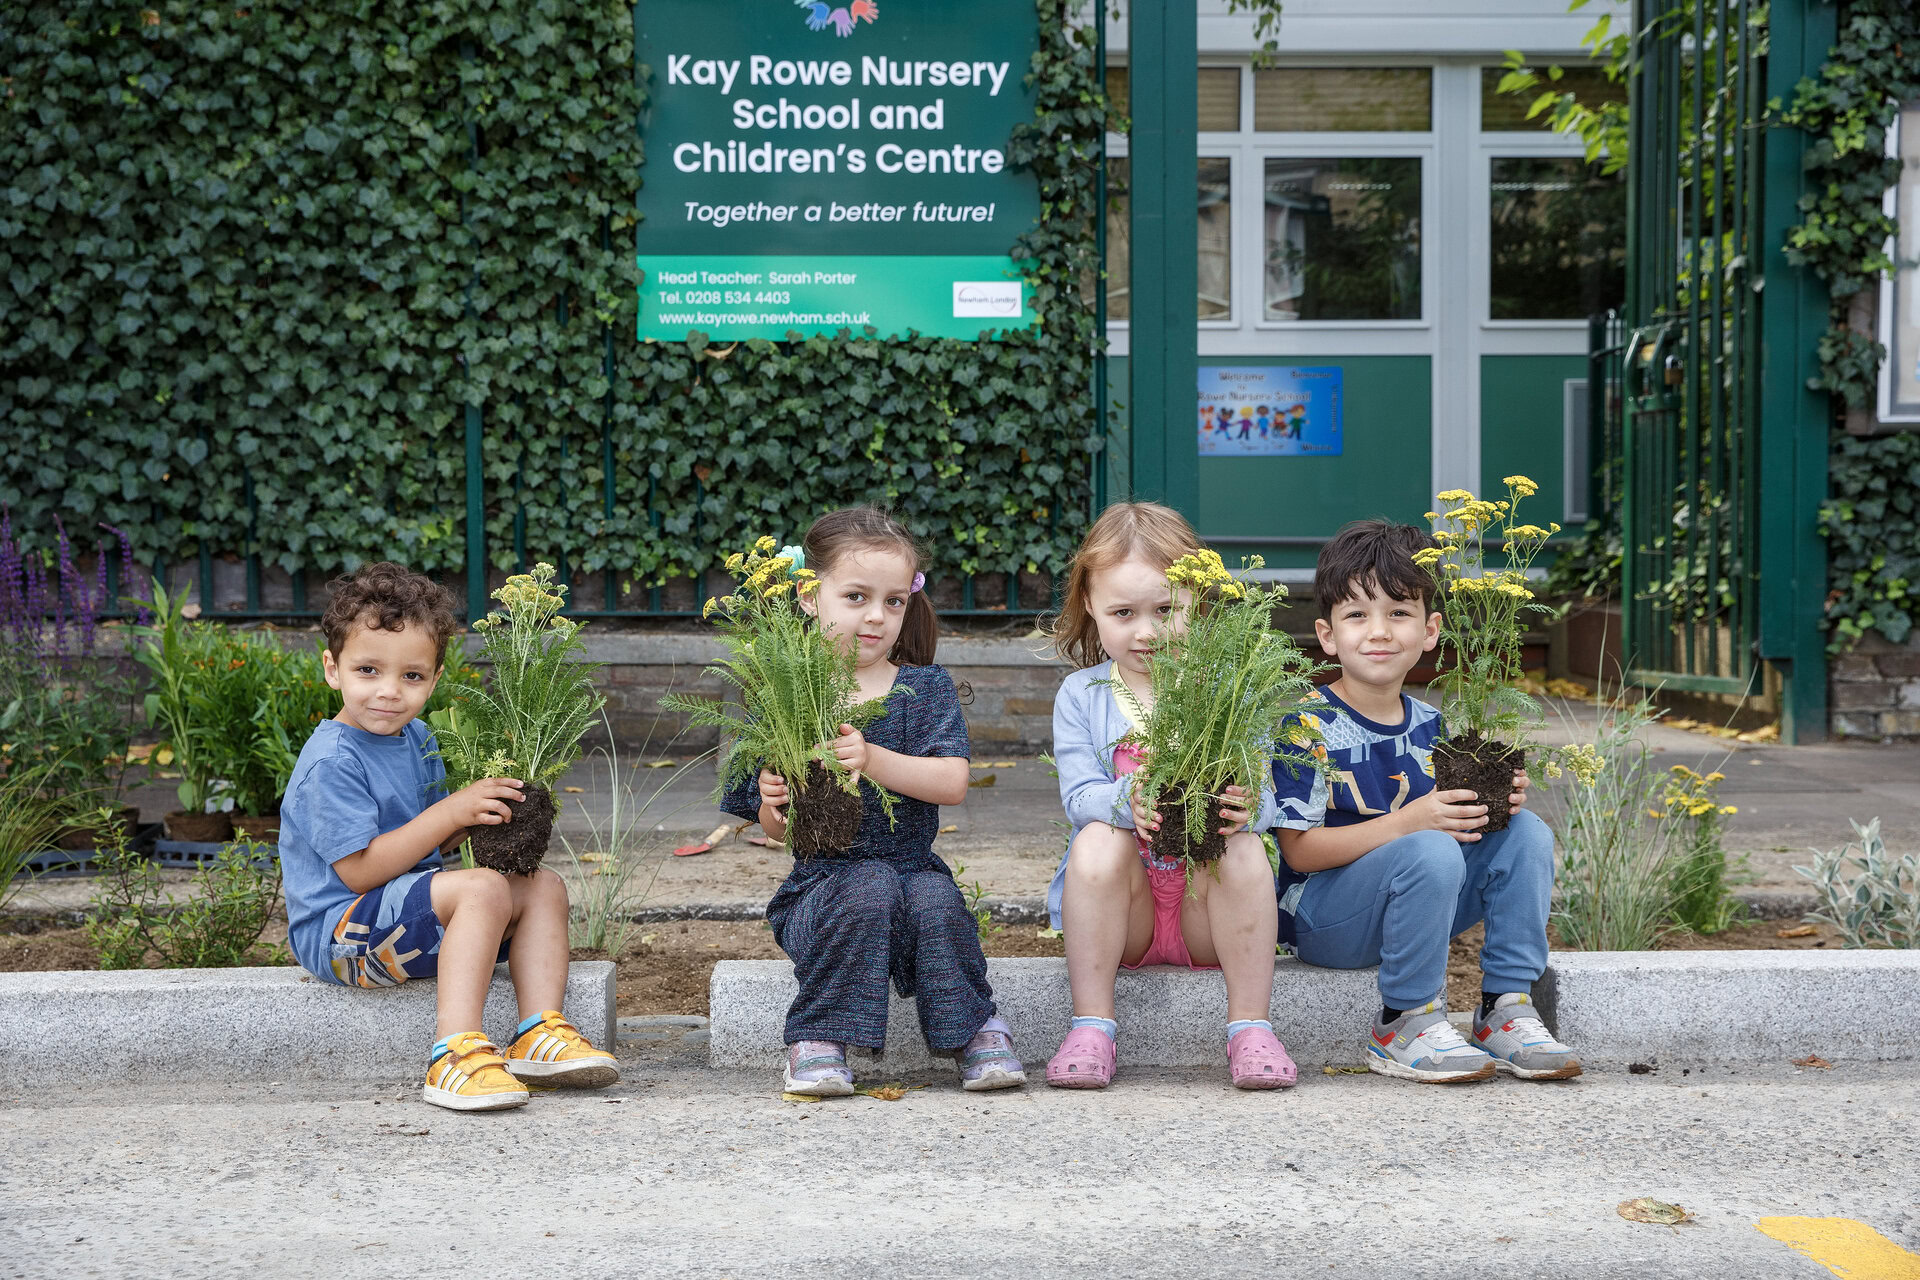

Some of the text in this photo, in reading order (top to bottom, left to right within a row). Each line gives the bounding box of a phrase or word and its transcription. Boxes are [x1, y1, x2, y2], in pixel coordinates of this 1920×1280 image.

[667, 54, 1010, 97] Kay Rowe Nursery
[732, 98, 944, 130] School and
[673, 140, 1005, 174] Children’s Centre
[684, 201, 995, 228] Together a better future!
[658, 271, 857, 285] Head Teacher: Sarah Porter
[659, 291, 791, 305] Tel. 0208 534 4403
[658, 311, 871, 327] www.kayrowe.newham.sch.uk
